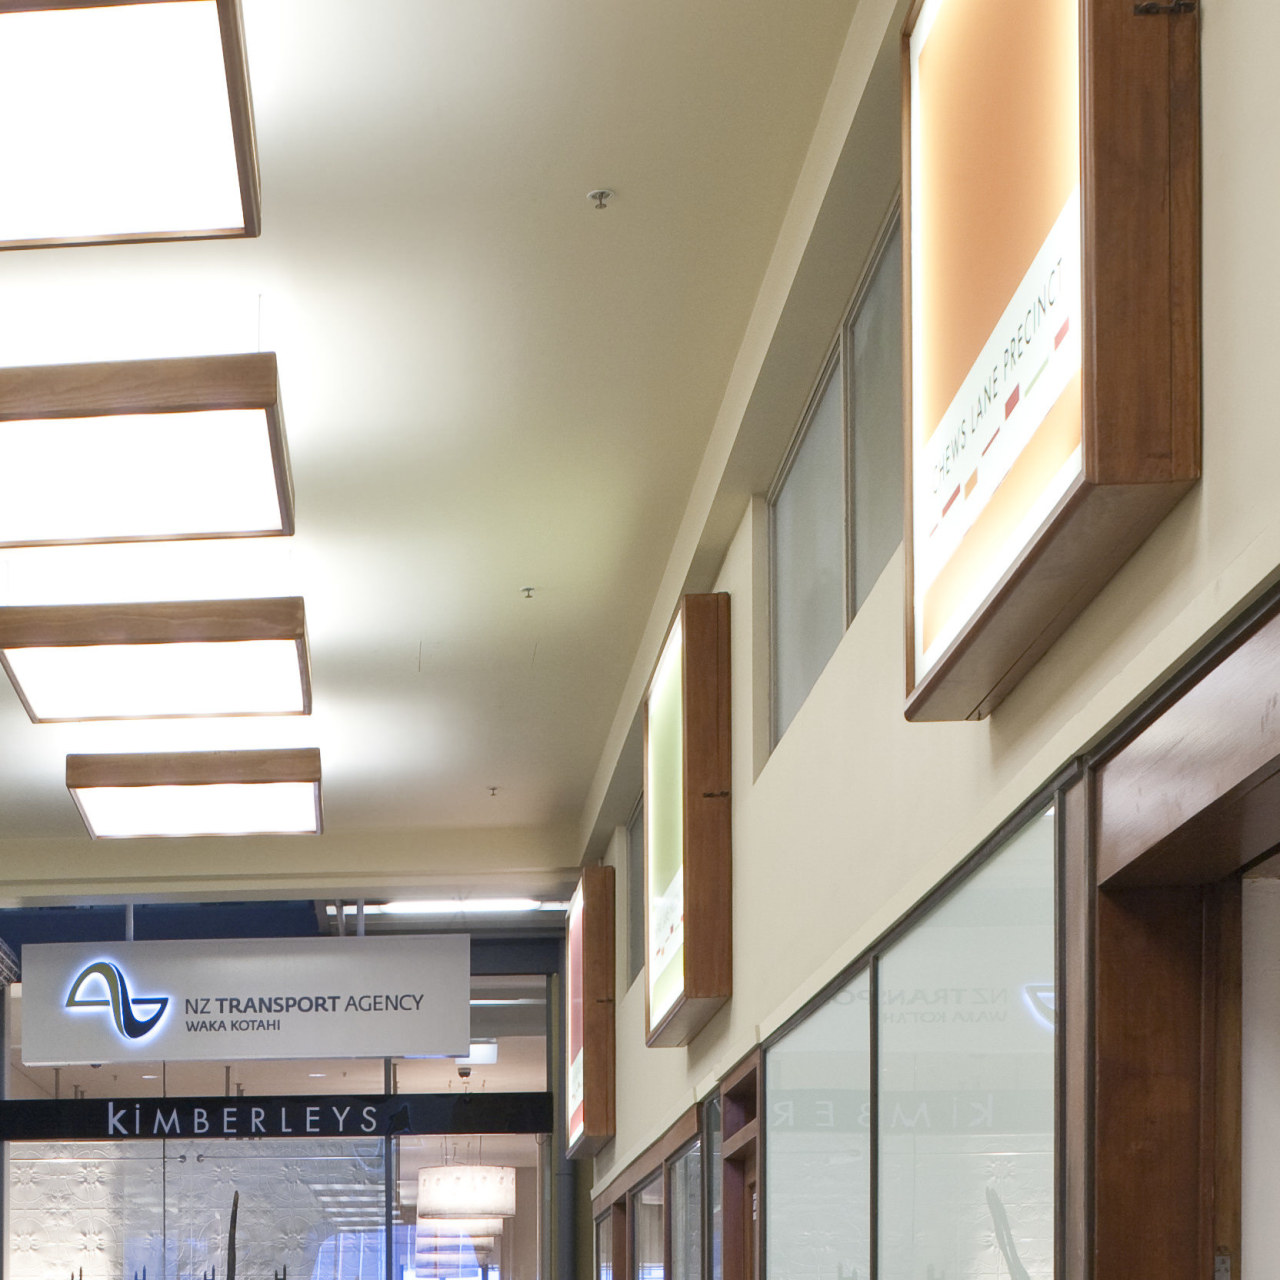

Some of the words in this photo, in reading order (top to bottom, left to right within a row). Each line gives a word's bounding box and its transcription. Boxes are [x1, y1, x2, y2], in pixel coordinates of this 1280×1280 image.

[933, 418, 967, 494] HEWS
[970, 365, 999, 434] LANE
[1003, 257, 1063, 382] PRECINCT
[184, 997, 211, 1015] NZ
[215, 995, 341, 1015] TRANSPORT
[343, 993, 424, 1012] AGENCY
[185, 1020, 227, 1032] WAKA
[230, 1019, 281, 1032] KOTAHI
